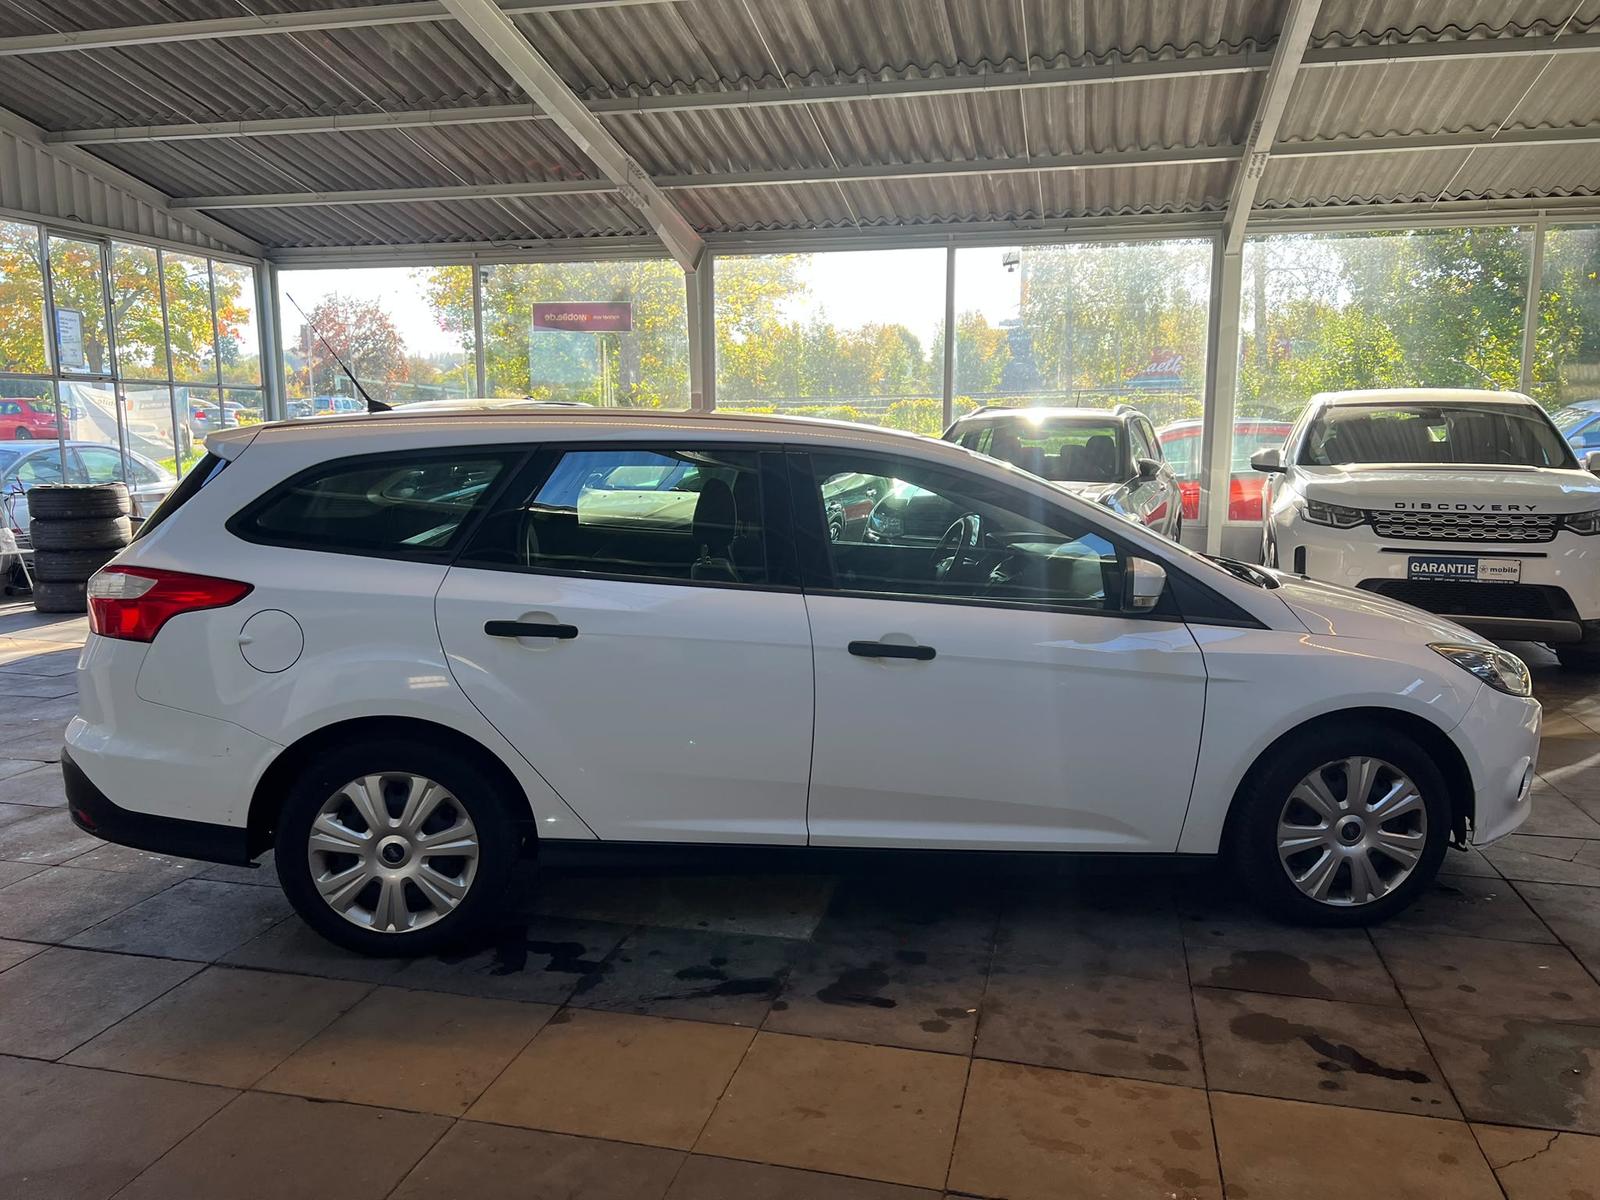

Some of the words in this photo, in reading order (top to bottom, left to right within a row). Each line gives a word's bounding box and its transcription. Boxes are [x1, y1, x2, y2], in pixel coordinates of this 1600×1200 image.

[1394, 502, 1538, 512] DISCOVERY
[1411, 562, 1476, 574] GARANTIE
[1490, 566, 1518, 574] mobile
